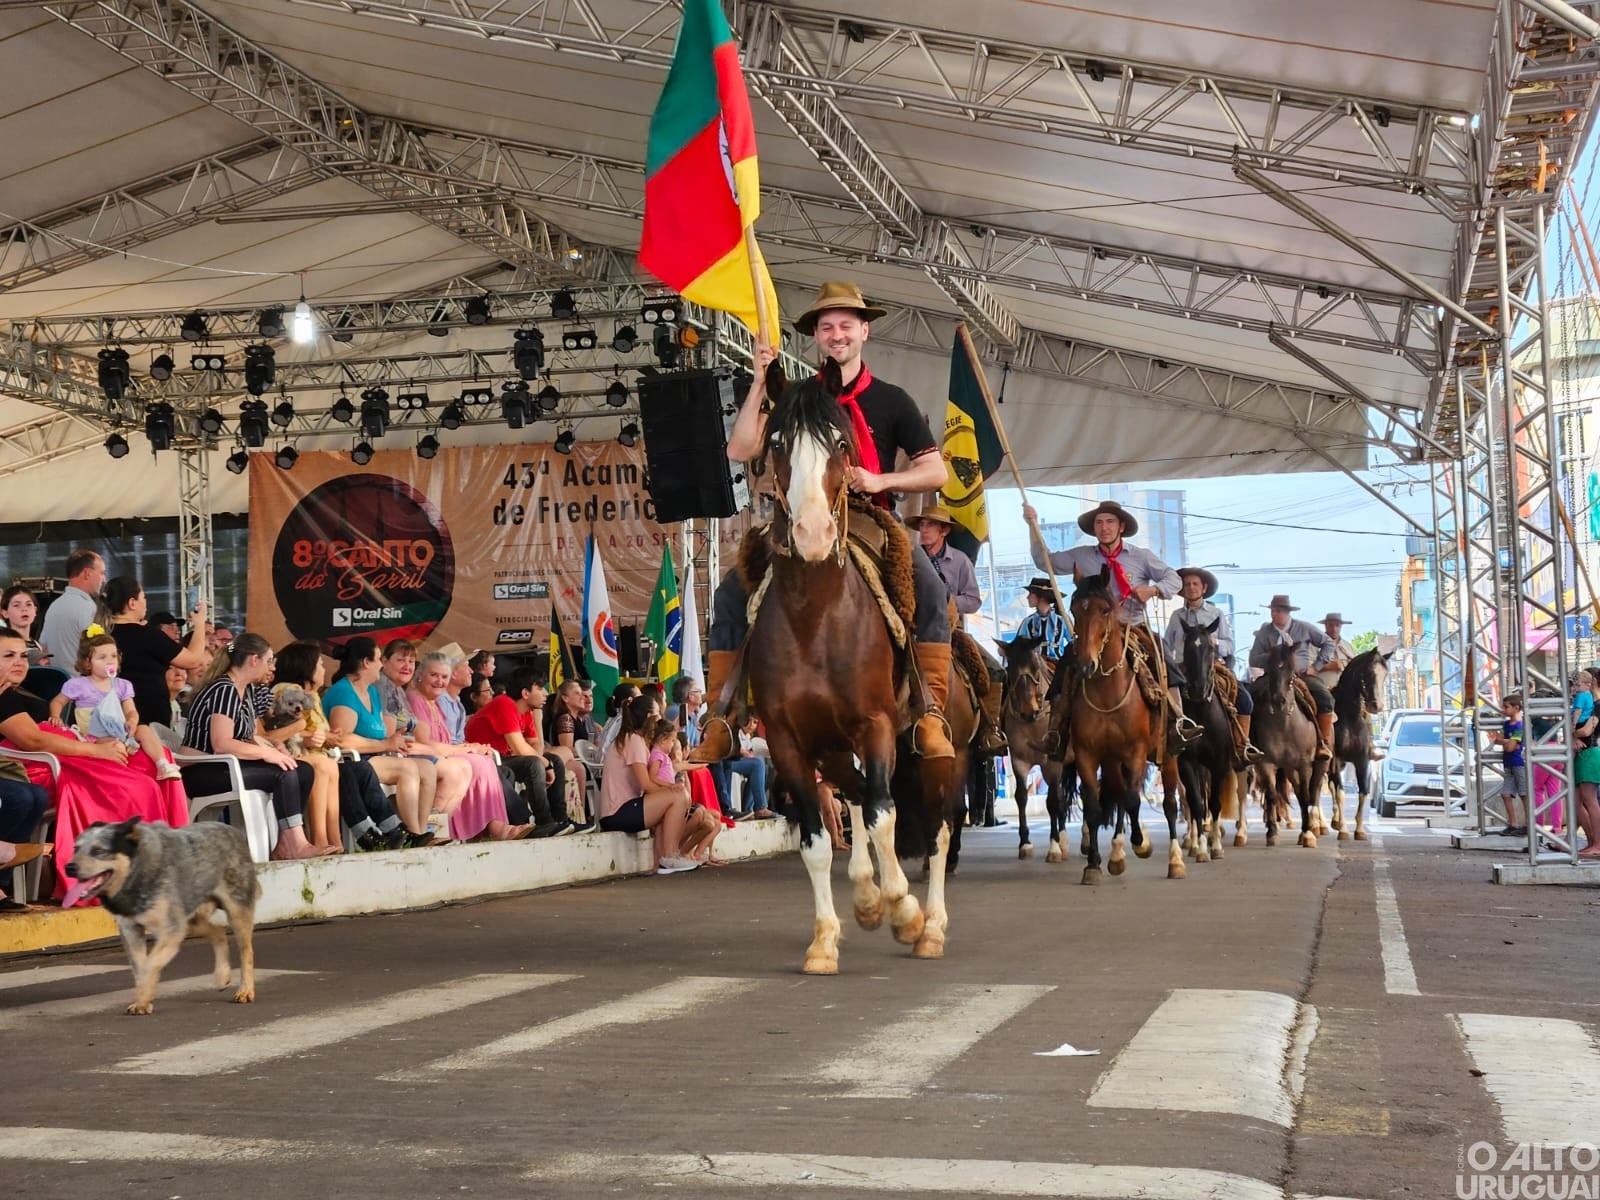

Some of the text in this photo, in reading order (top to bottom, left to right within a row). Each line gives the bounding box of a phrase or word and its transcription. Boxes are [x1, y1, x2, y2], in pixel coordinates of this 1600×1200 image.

[493, 498, 525, 525] de
[626, 534, 643, 548] 20
[328, 539, 435, 568] CANTO
[294, 547, 426, 601] do Barril
[509, 584, 546, 593] Oral Sin
[353, 608, 402, 619] Oral Sin
